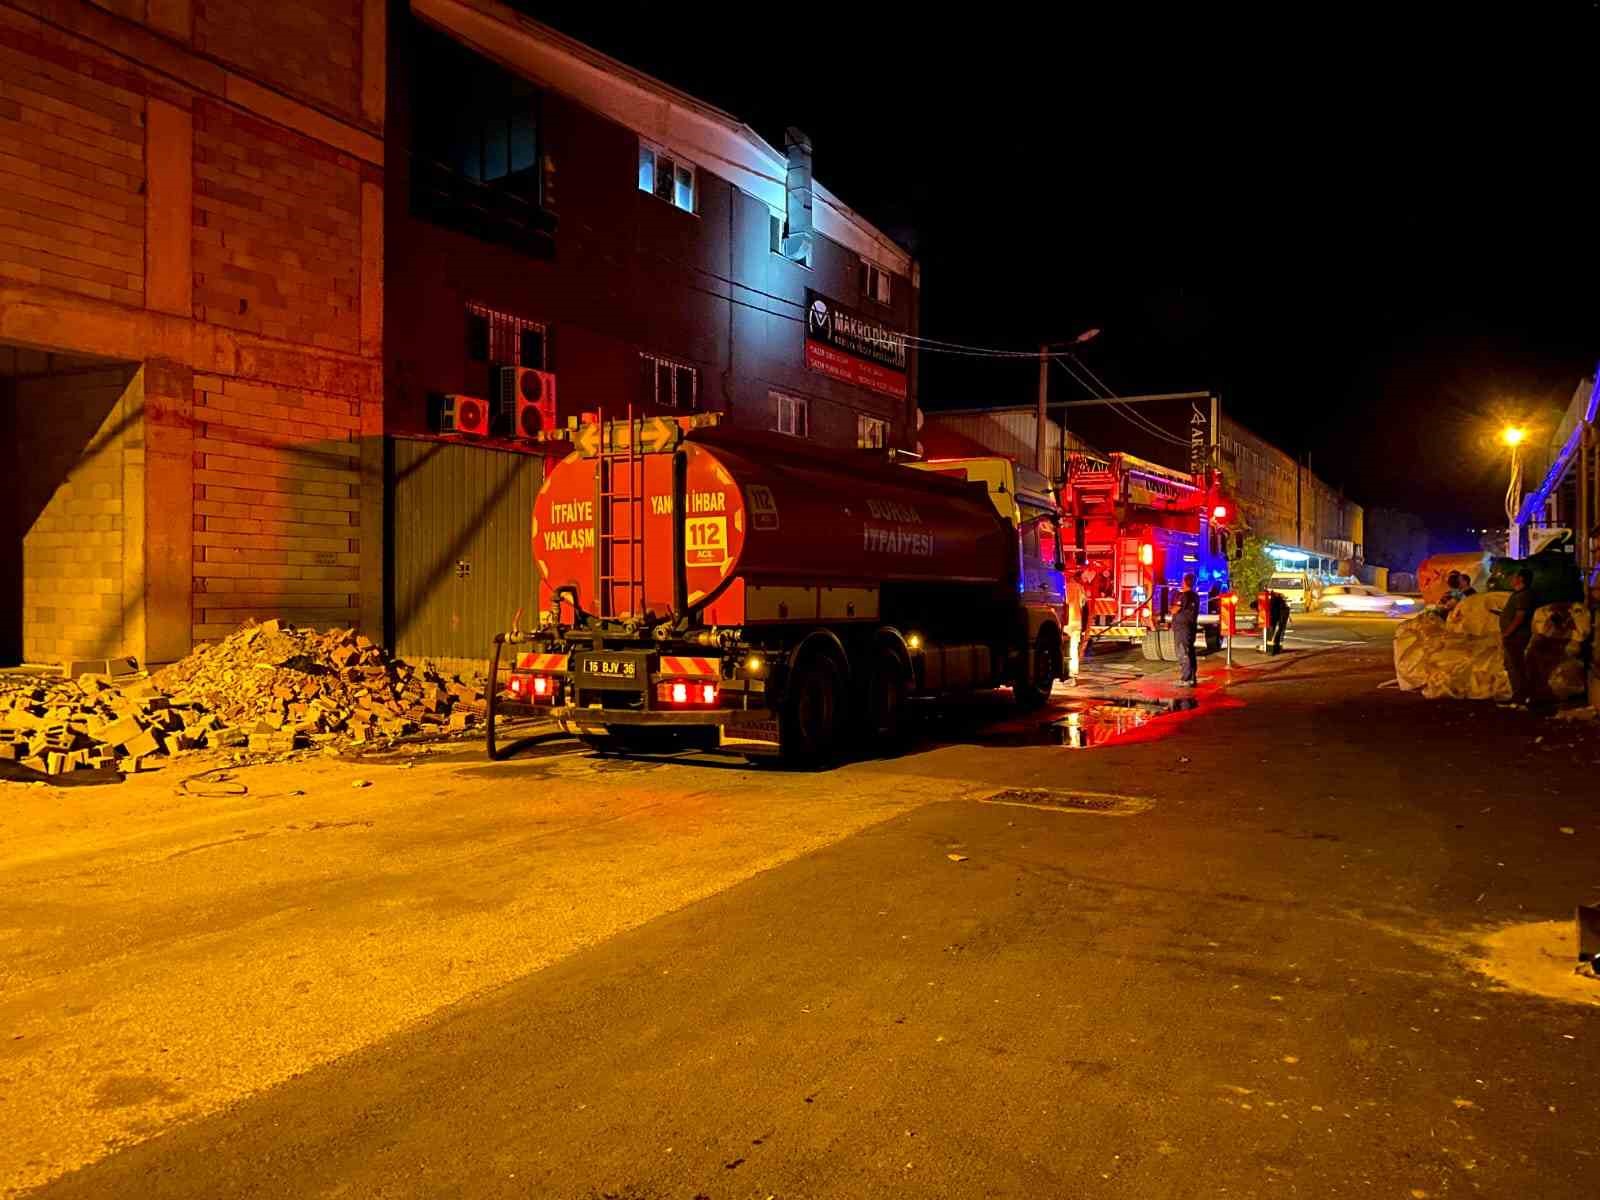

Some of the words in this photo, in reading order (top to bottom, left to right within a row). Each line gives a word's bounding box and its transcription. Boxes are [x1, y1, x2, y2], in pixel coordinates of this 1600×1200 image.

[552, 498, 593, 525] İTFAİYE
[692, 489, 726, 513] İHBAR
[864, 497, 924, 526] BURSA
[689, 522, 721, 545] 112
